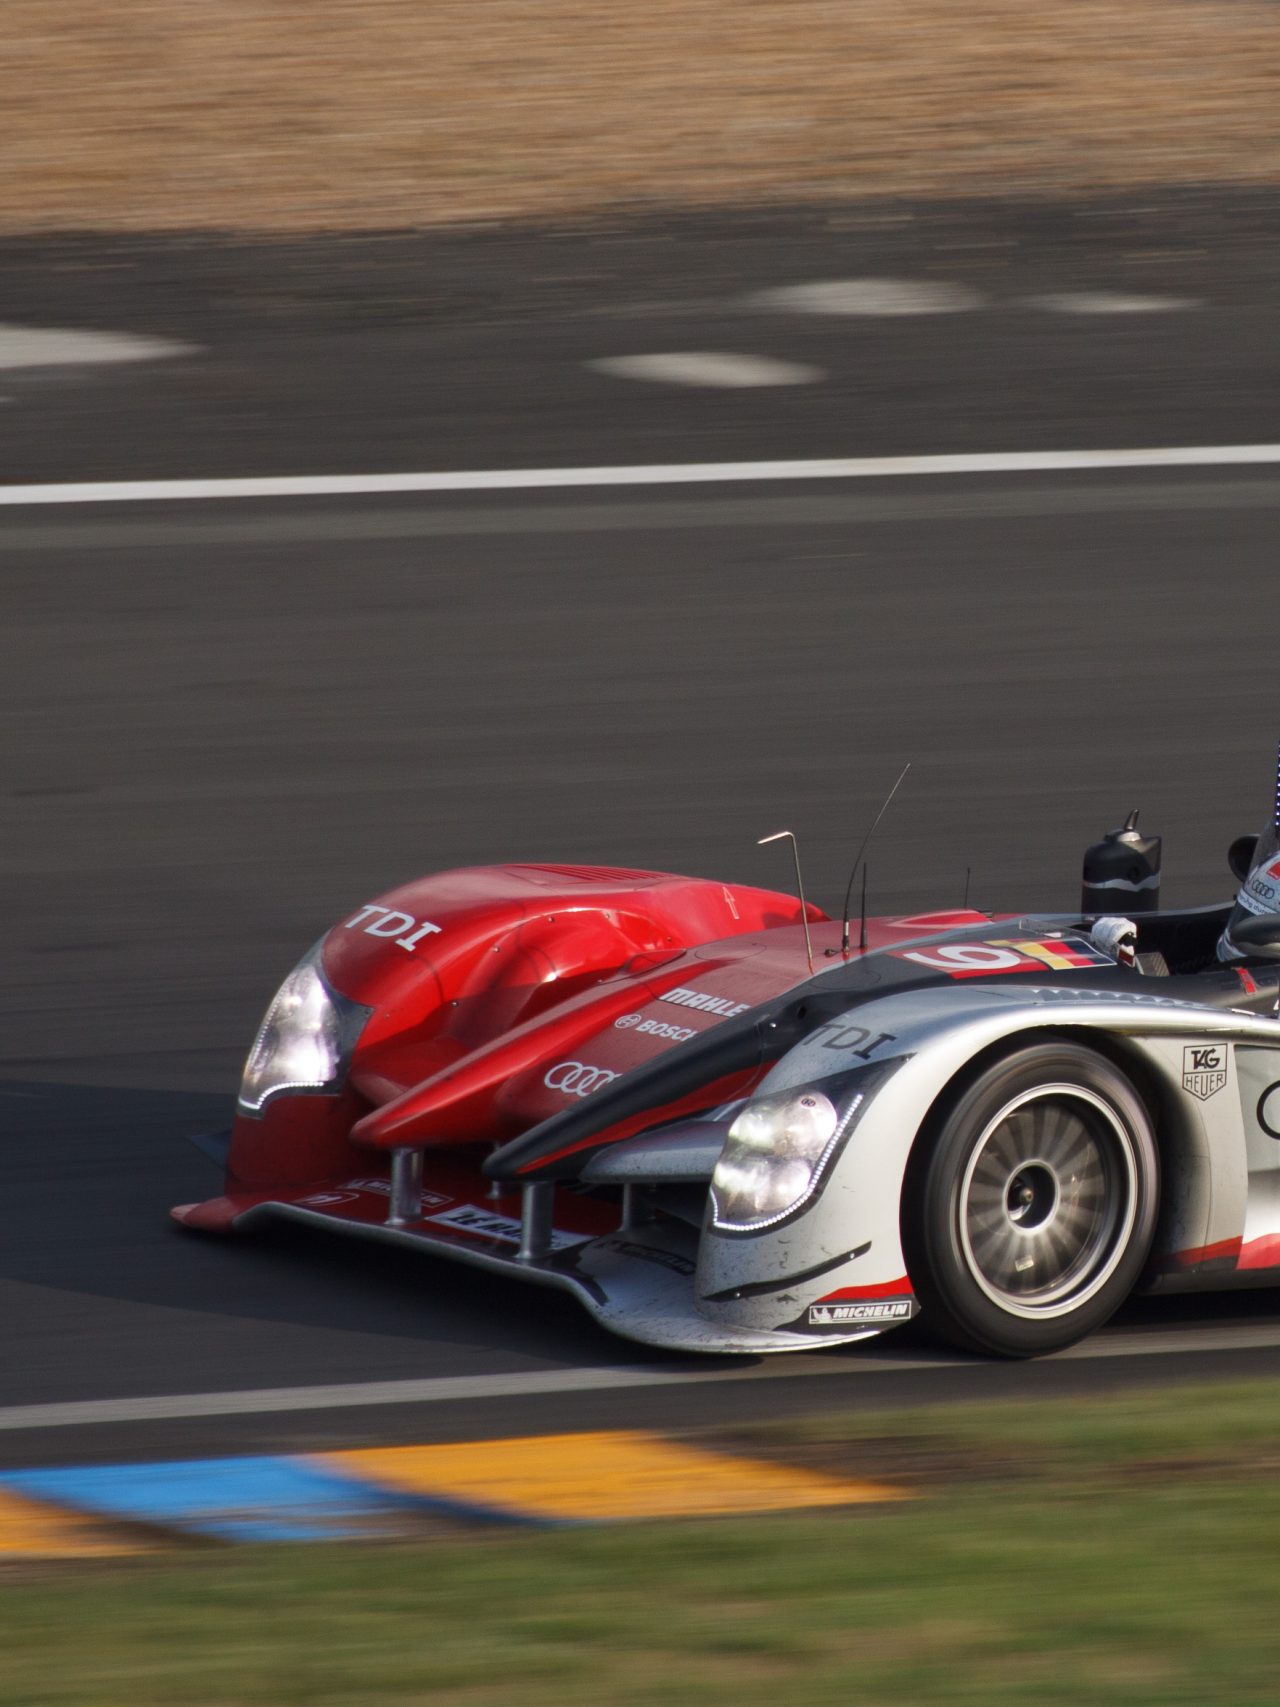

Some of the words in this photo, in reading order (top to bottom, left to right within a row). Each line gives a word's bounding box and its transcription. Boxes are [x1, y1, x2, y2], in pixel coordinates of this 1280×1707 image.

[344, 904, 442, 952] TDI
[658, 987, 753, 1018] MAHLE
[802, 1023, 899, 1060] TDI
[1191, 1048, 1221, 1070] TAG
[1186, 1073, 1224, 1097] HEUER
[833, 1303, 908, 1319] MICHELIN
